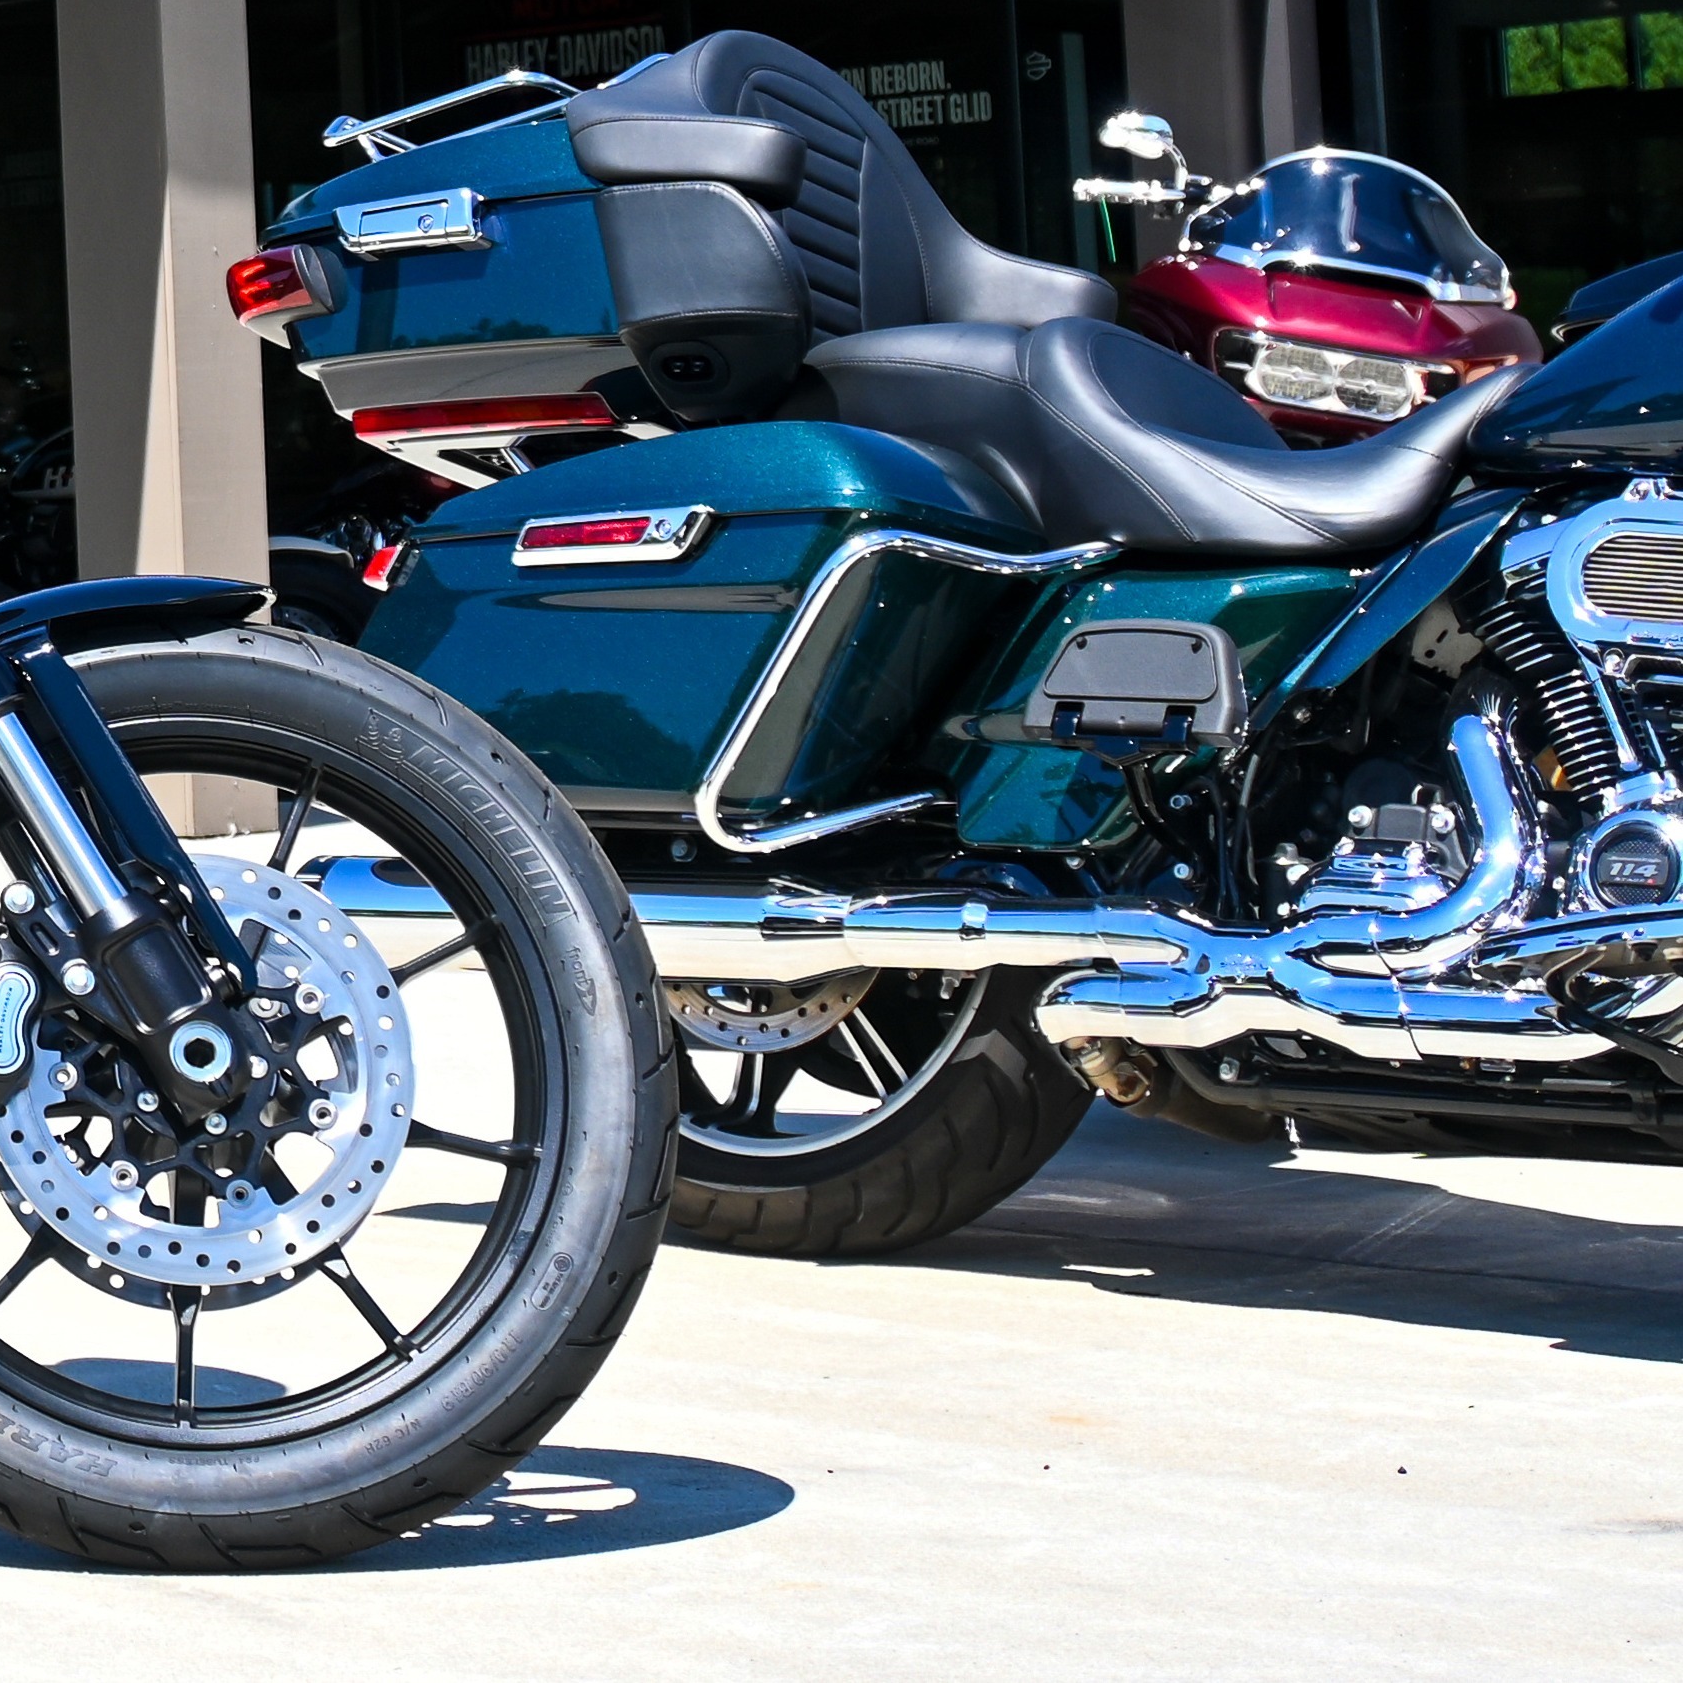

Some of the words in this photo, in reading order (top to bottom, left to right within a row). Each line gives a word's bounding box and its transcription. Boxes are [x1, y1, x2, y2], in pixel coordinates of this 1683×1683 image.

[870, 60, 952, 96] REBORN.
[877, 94, 946, 128] STREET
[949, 90, 993, 125] GLID
[407, 744, 572, 922] MICHELIN
[1609, 862, 1659, 878] 114
